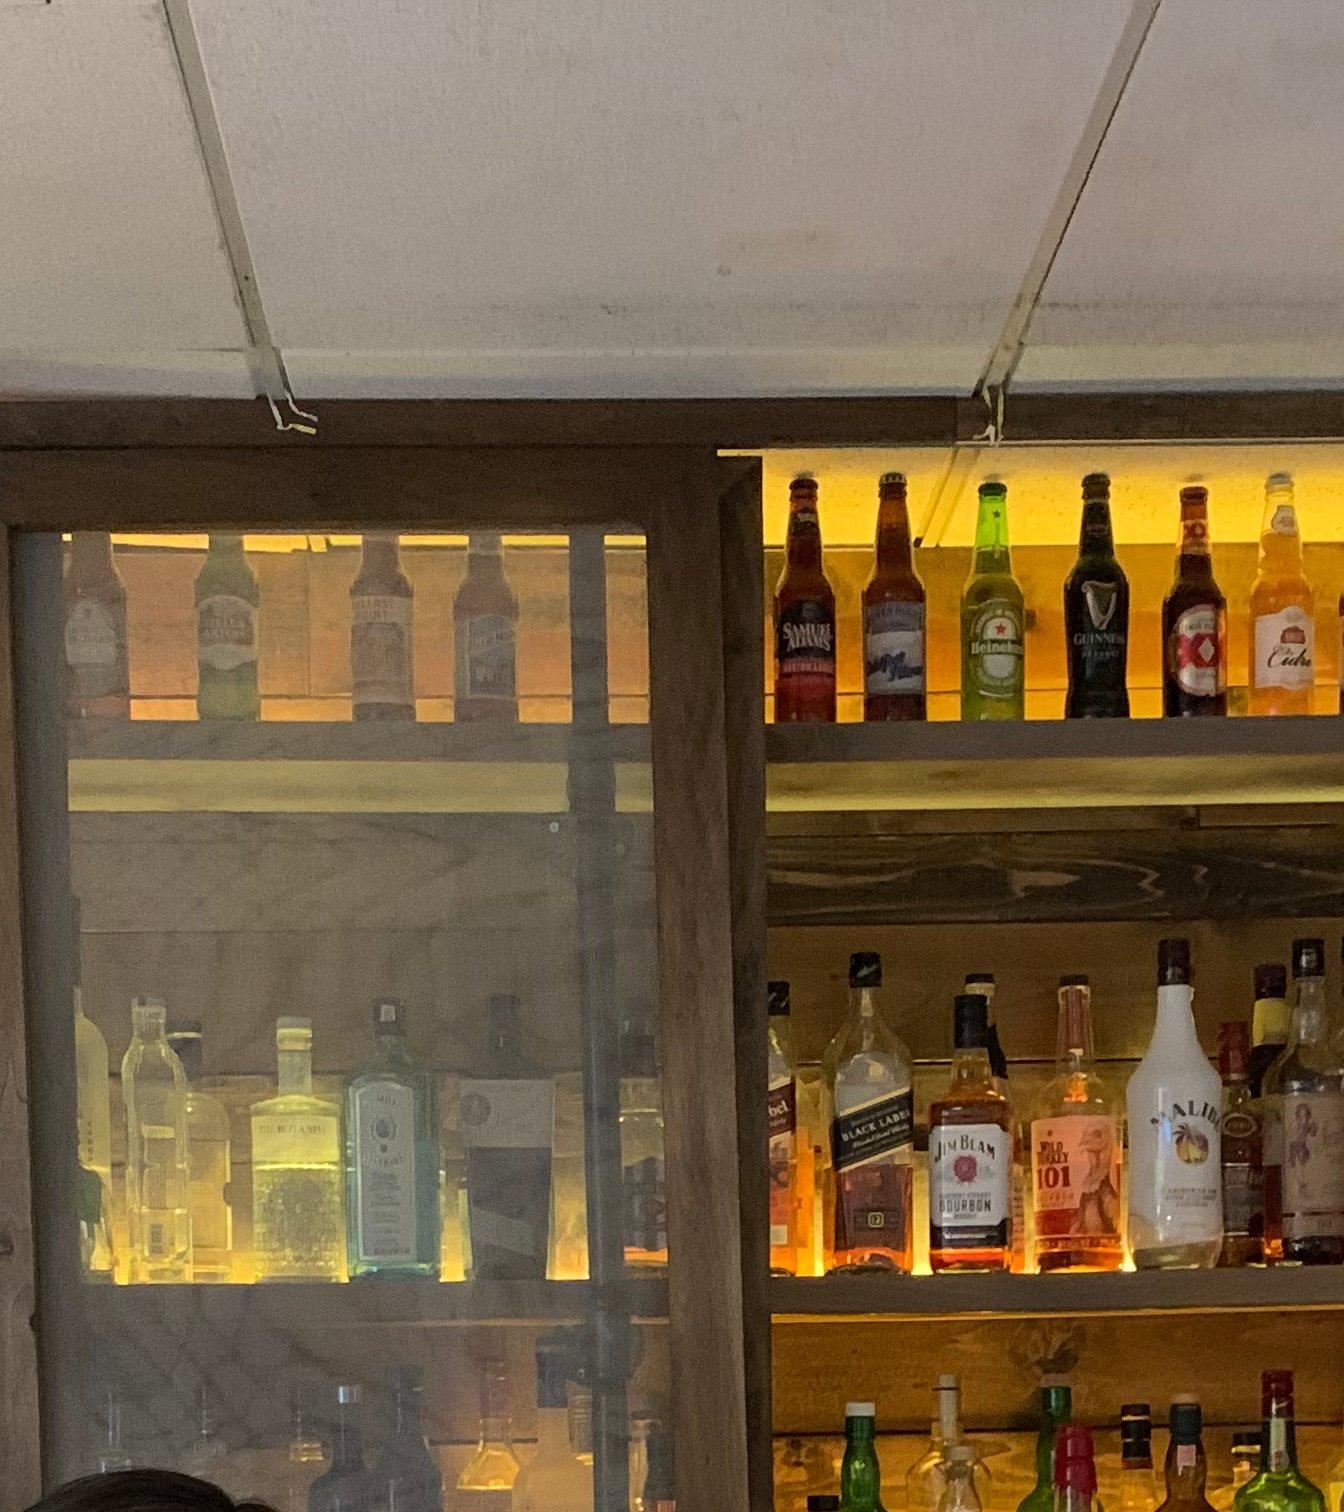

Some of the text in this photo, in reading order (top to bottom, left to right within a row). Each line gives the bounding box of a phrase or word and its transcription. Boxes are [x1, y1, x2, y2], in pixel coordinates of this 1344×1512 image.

[787, 636, 831, 652] ADAMS
[768, 1099, 790, 1118] bel
[841, 1121, 877, 1143] BLACK
[878, 1108, 911, 1128] LABEL
[934, 1138, 958, 1163] JIM
[1036, 1165, 1071, 1190] 101
[939, 1198, 992, 1213] BOURBON
